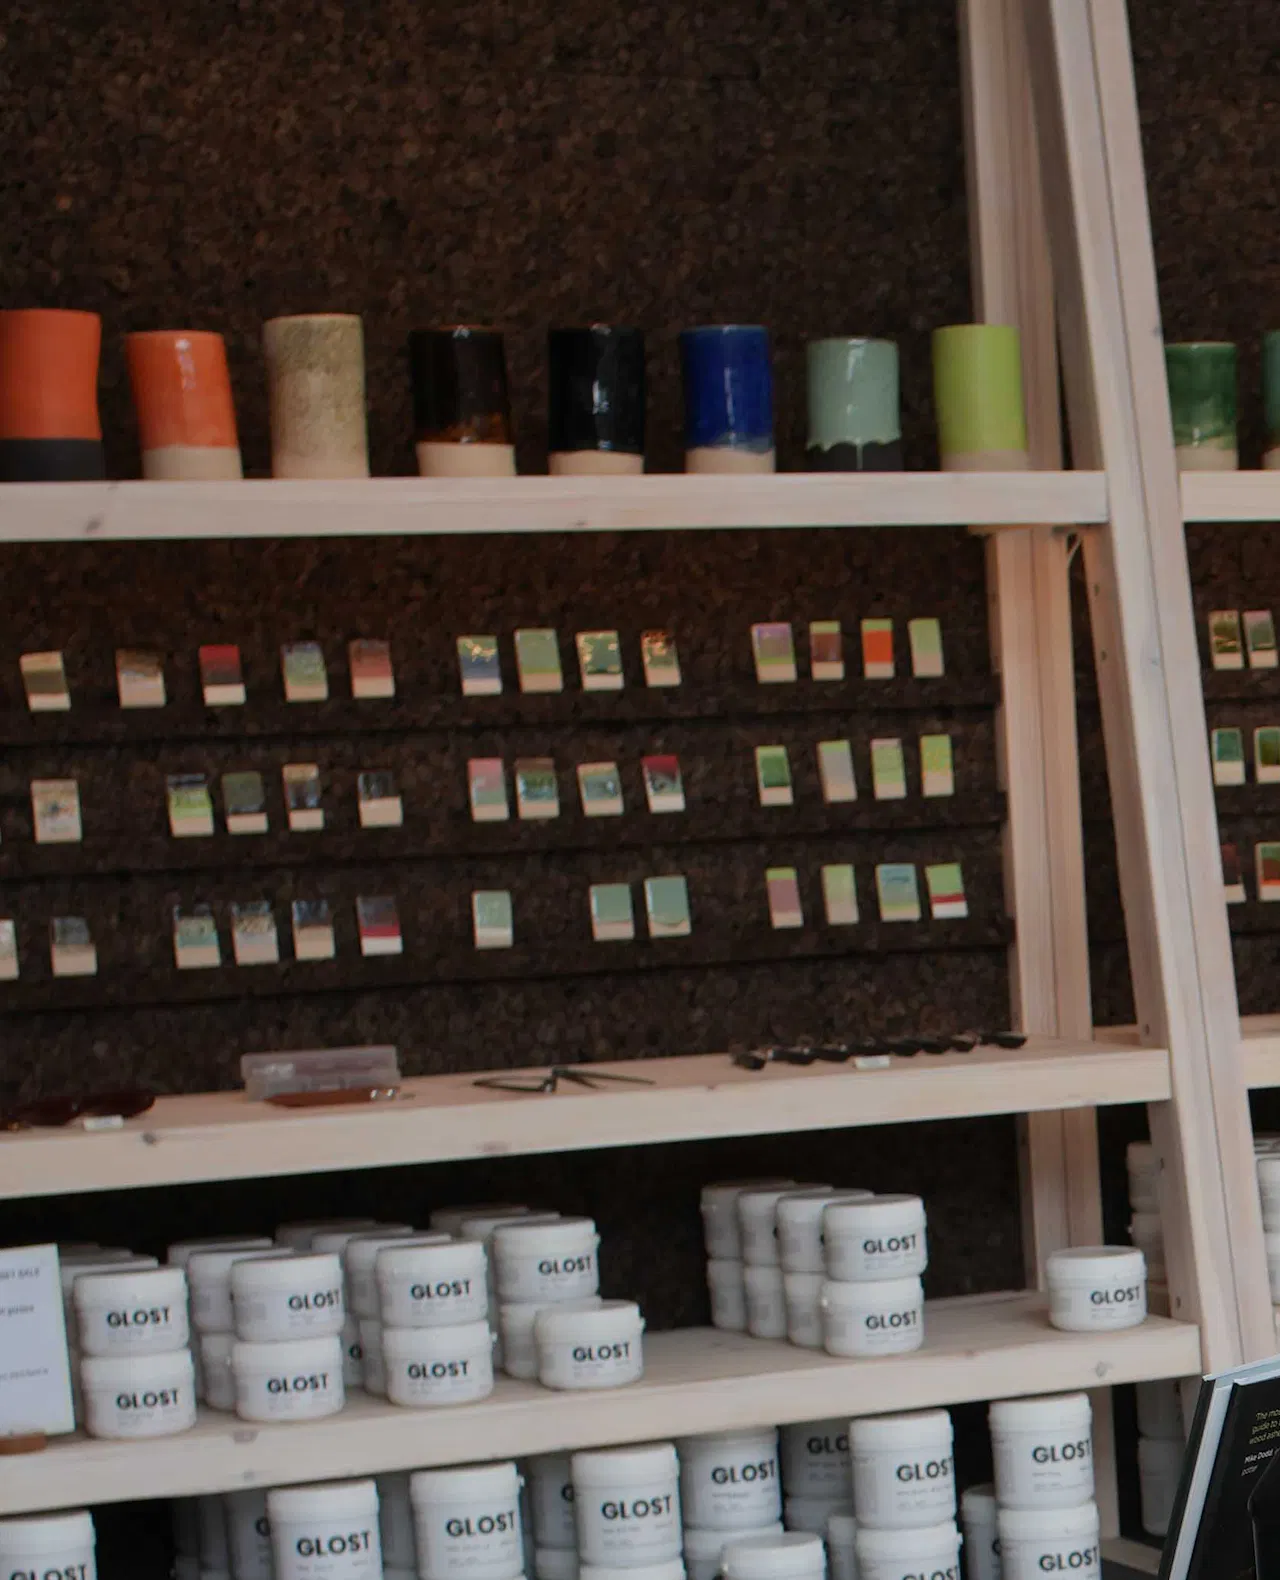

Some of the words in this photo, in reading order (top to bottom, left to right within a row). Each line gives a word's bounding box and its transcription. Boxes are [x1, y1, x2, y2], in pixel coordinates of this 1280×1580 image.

[864, 1234, 917, 1254] GLOST
[538, 1256, 592, 1275] GLOST
[410, 1280, 471, 1299] GLOST
[1090, 1286, 1141, 1305] GLOST
[288, 1289, 340, 1311] GLOST
[107, 1307, 172, 1327] GLOST
[865, 1310, 917, 1329] GLOST
[572, 1342, 631, 1363] GLOST
[407, 1361, 470, 1380] GLOST
[267, 1374, 329, 1394] GLOST
[116, 1389, 180, 1409] GLOST
[806, 1435, 850, 1458] GLO
[1032, 1439, 1091, 1463] GLOST
[712, 1460, 775, 1486] GLOST
[602, 1497, 672, 1520] GLOST
[446, 1511, 516, 1537] GLOST
[296, 1531, 371, 1557] GLOST
[1039, 1547, 1098, 1572] GLOST
